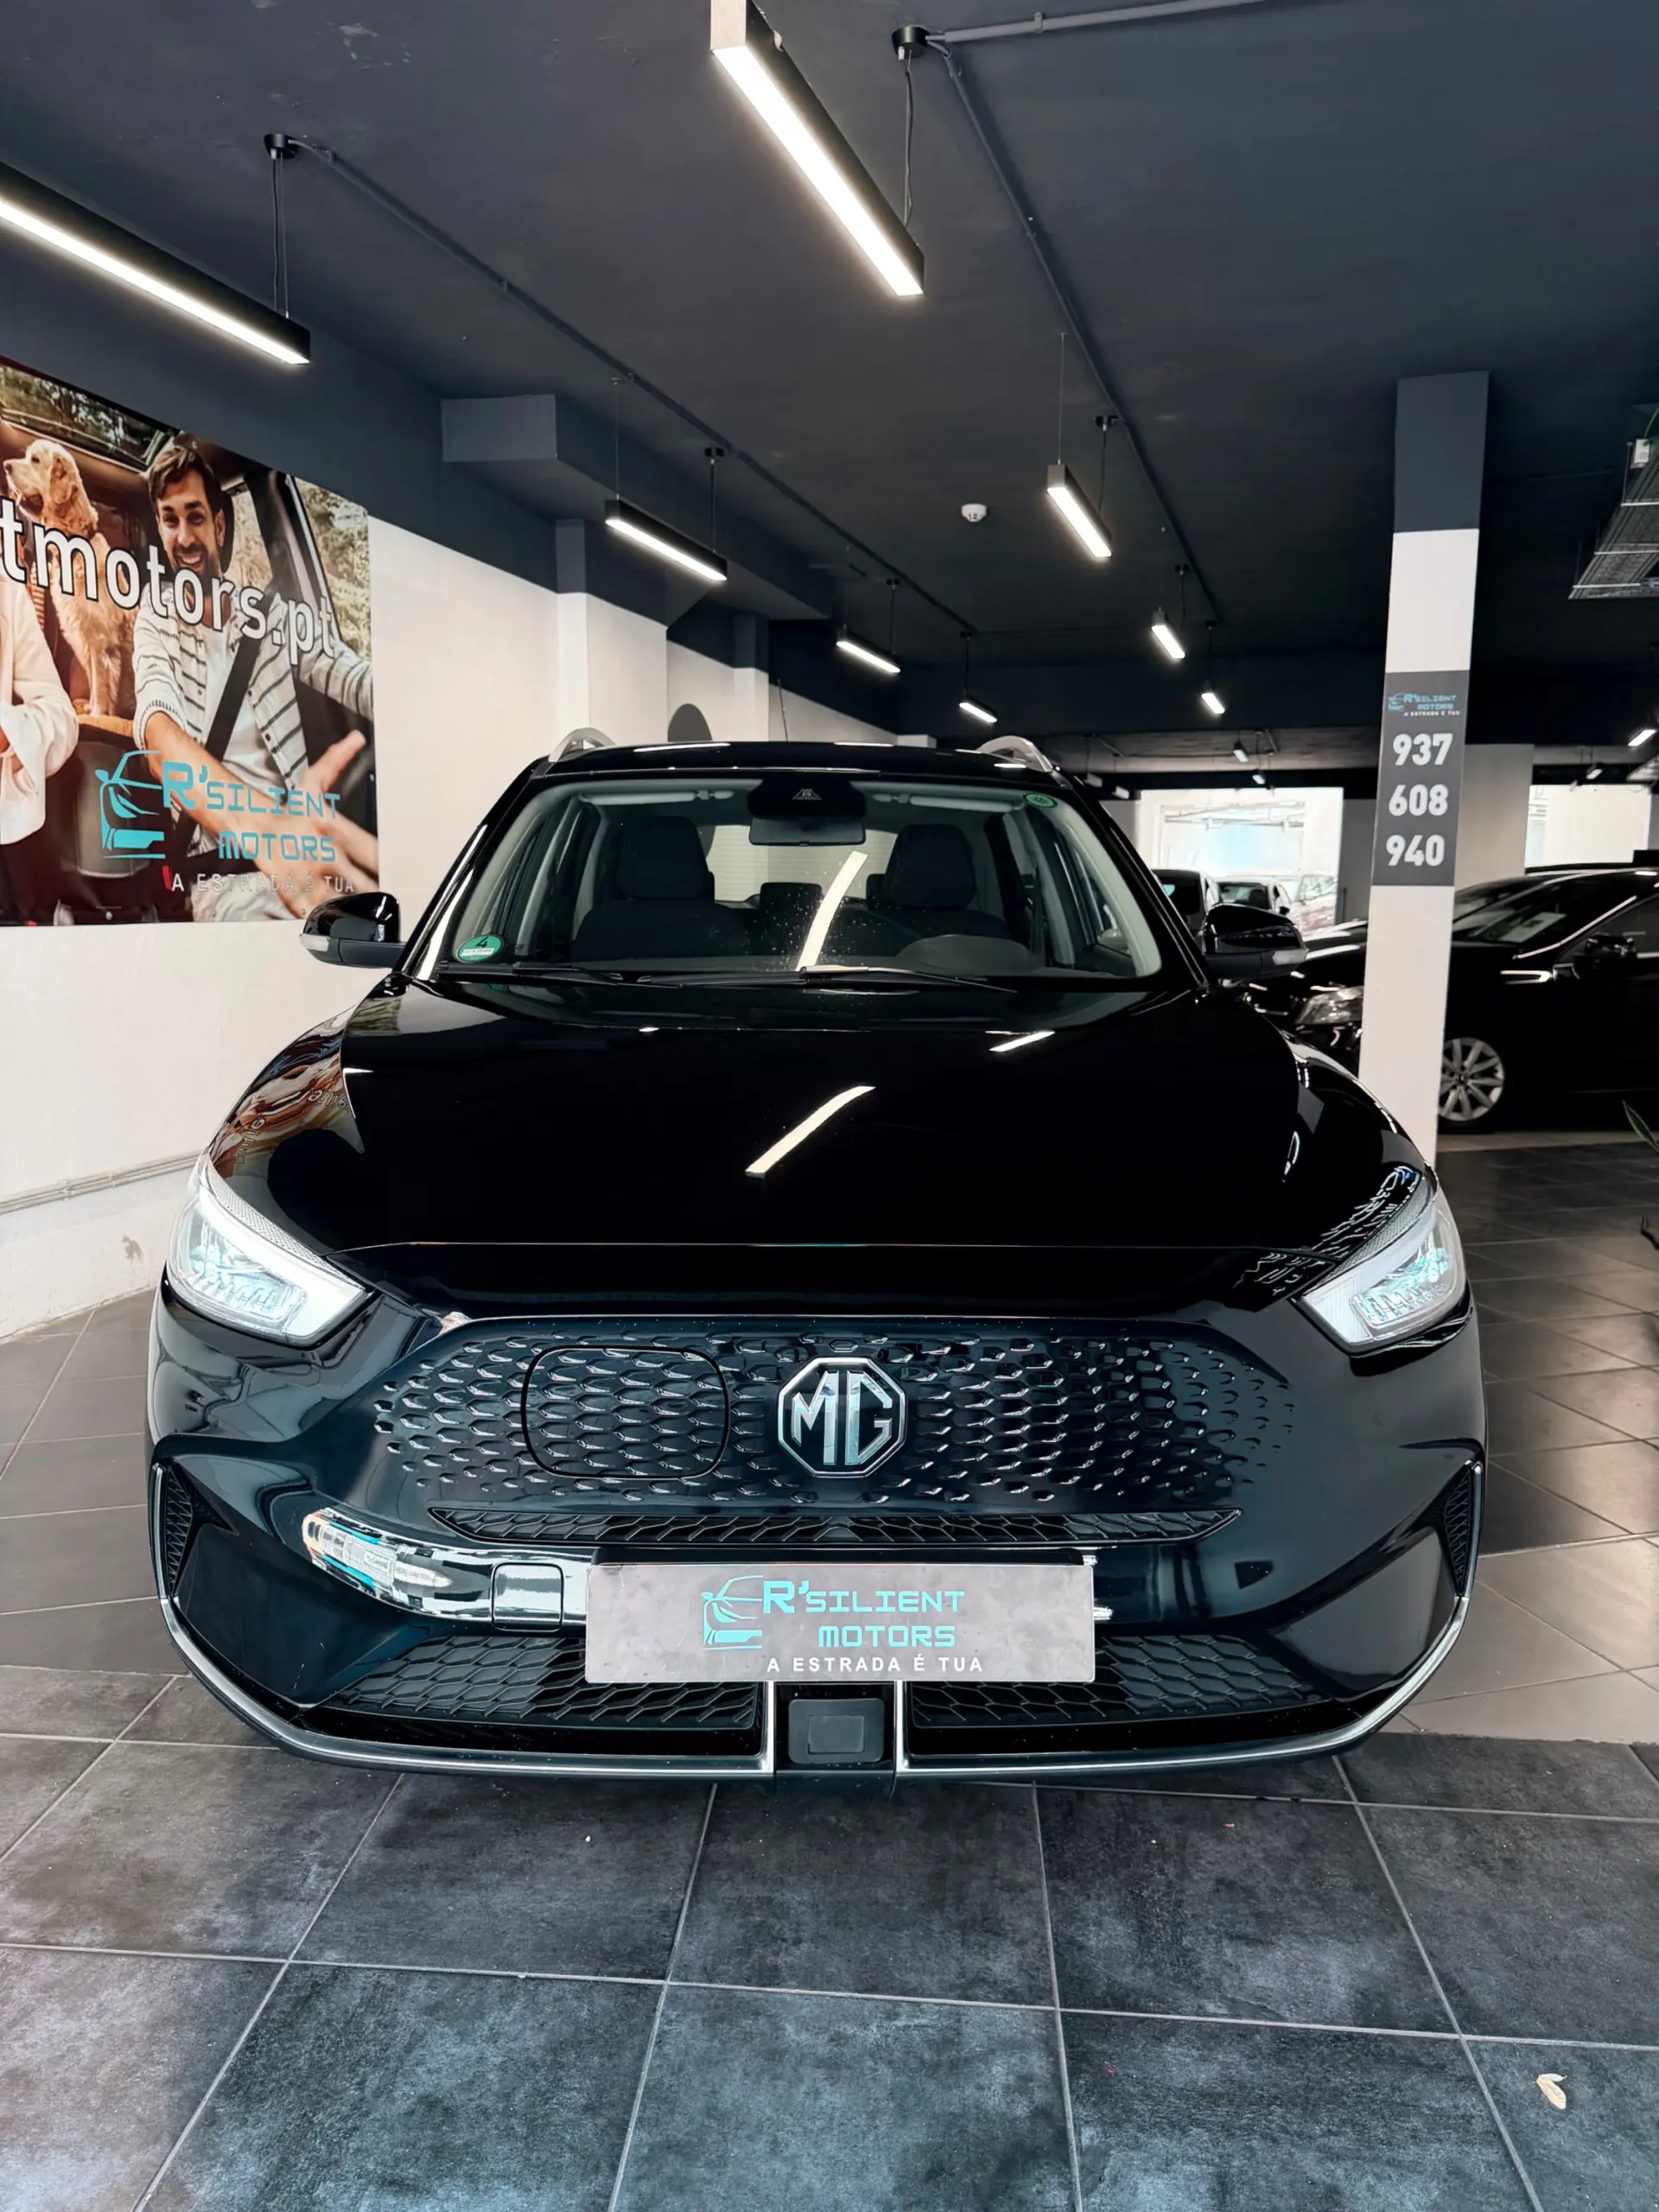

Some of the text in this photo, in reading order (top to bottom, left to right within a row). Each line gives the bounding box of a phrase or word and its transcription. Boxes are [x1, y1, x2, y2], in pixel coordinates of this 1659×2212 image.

[1393, 733, 1452, 766] 937
[162, 760, 340, 819] R'SILIENT
[1389, 784, 1448, 816] 608
[218, 830, 336, 862] MOTORS
[1386, 835, 1445, 866] 940
[172, 873, 184, 892] A
[197, 873, 296, 893] ESTRADA
[324, 875, 354, 893] TUA
[475, 936, 489, 948] 4
[791, 1370, 893, 1465] MG
[763, 1580, 965, 1613] R'SILIENT
[818, 1625, 956, 1647] MOTORS
[767, 1653, 982, 1672] A ESTRADA É TUA
